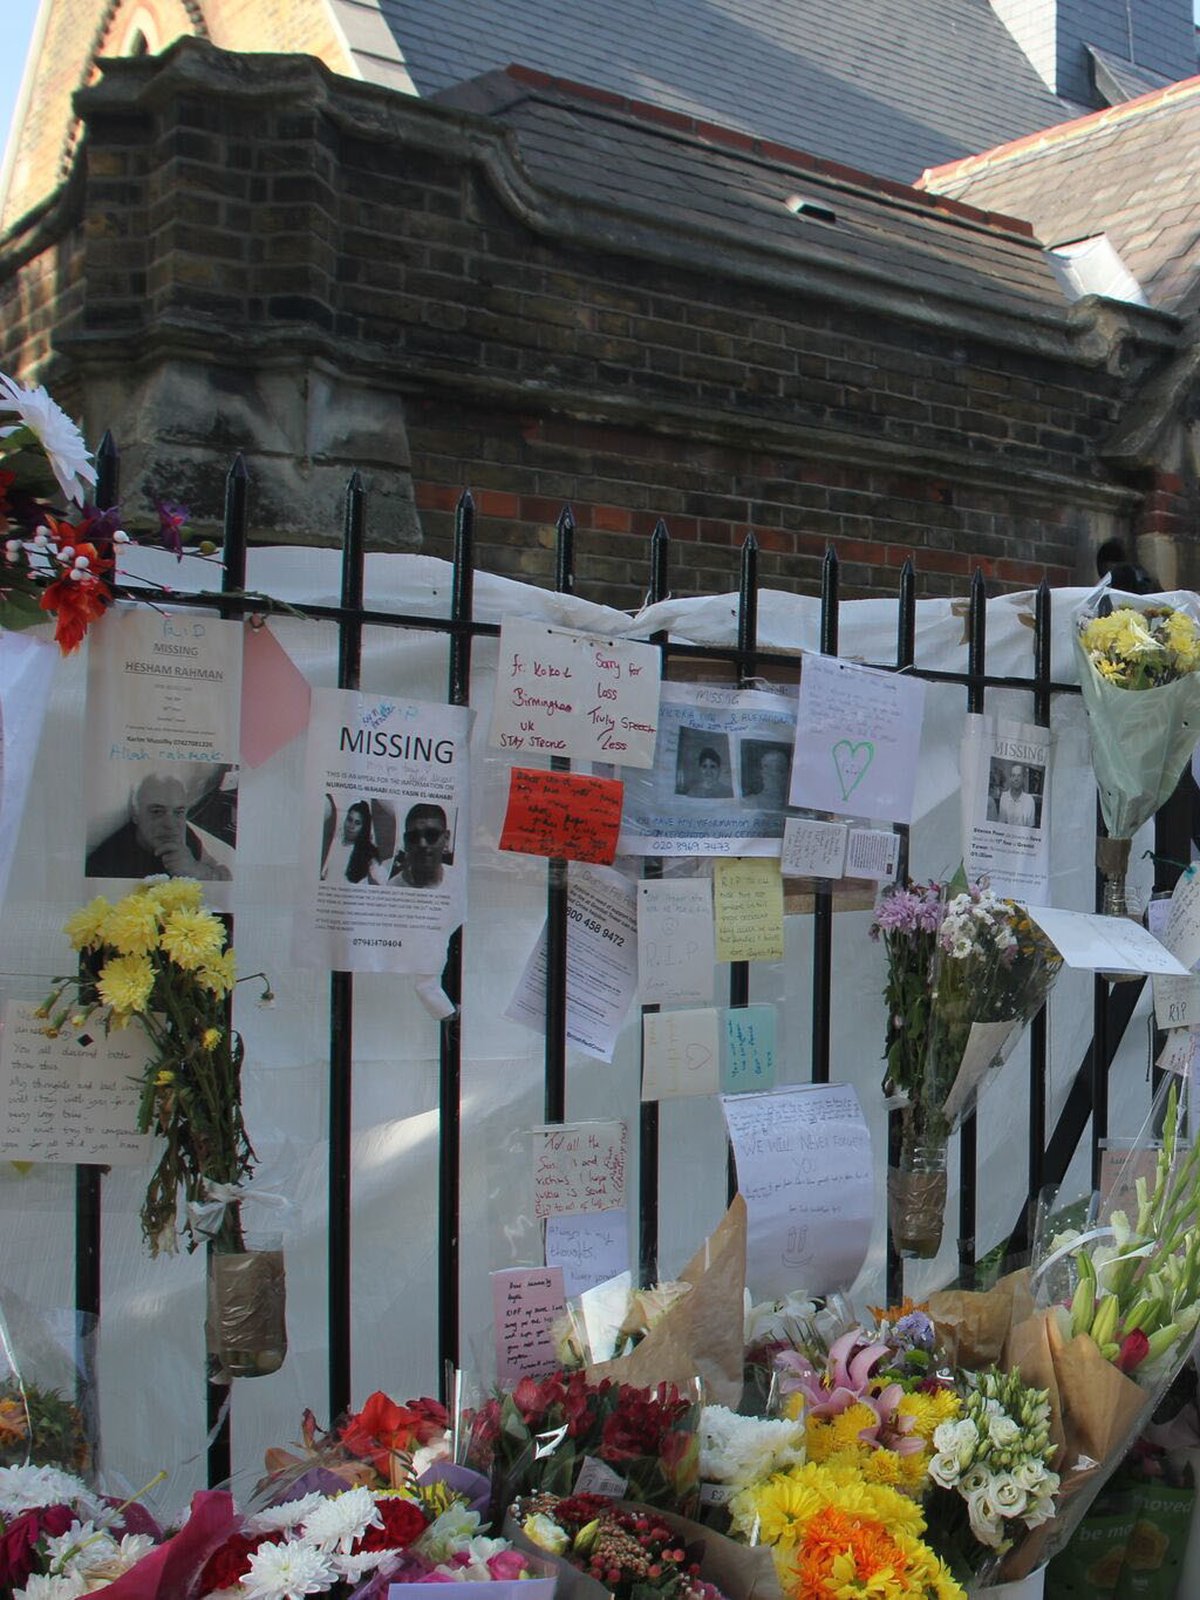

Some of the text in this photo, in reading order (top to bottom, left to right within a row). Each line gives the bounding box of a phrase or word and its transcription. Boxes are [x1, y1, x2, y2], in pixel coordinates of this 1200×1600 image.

[153, 643, 199, 657] MISSING
[125, 661, 223, 680] HESHAM RAHMAN
[512, 687, 572, 716] Birmingham
[340, 727, 454, 764] MISSING
[500, 733, 524, 749] STAY
[994, 741, 1044, 763] MISSING
[652, 841, 730, 852] 020 8969 7473
[582, 917, 626, 947] 458 9472
[1080, 1527, 1103, 1541] be
